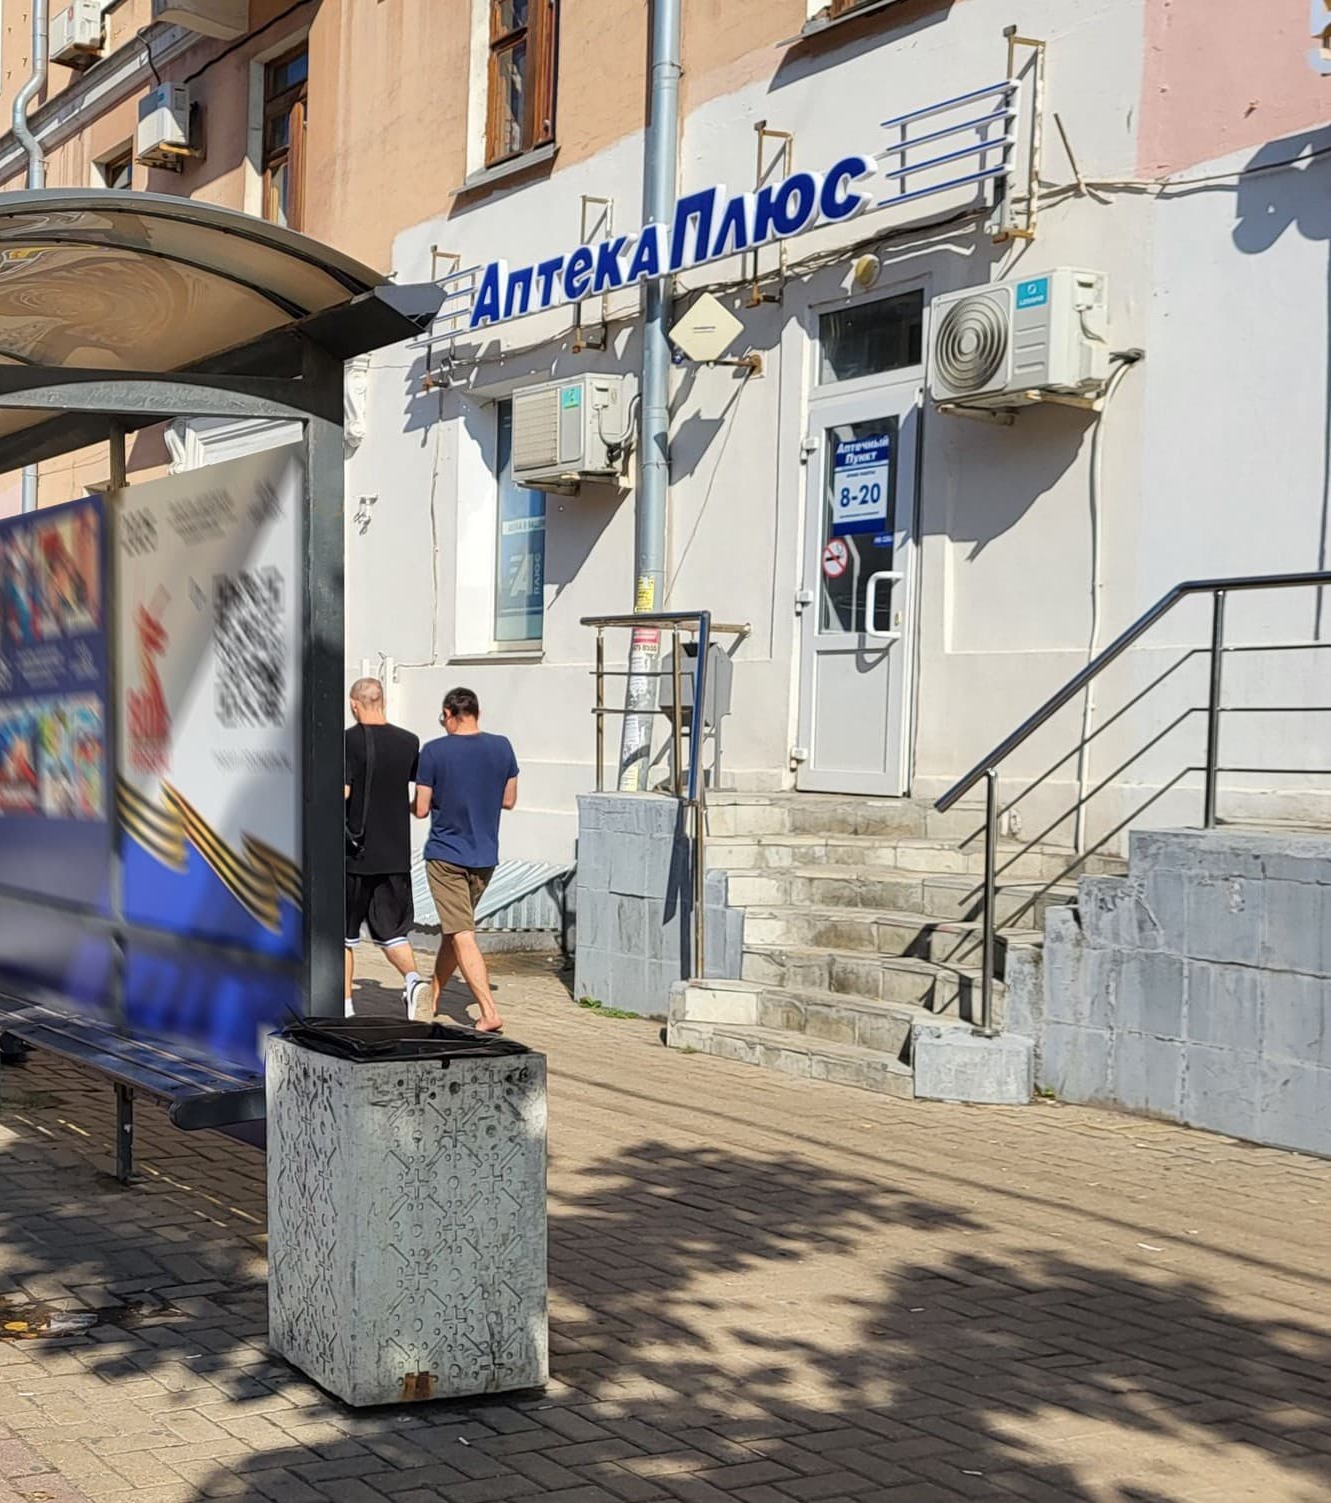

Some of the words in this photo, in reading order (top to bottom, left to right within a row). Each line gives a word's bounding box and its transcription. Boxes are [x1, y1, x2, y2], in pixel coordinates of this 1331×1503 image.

[836, 434, 890, 454] Аптечный
[844, 450, 878, 465] Пункт
[839, 482, 882, 508] 8-20
